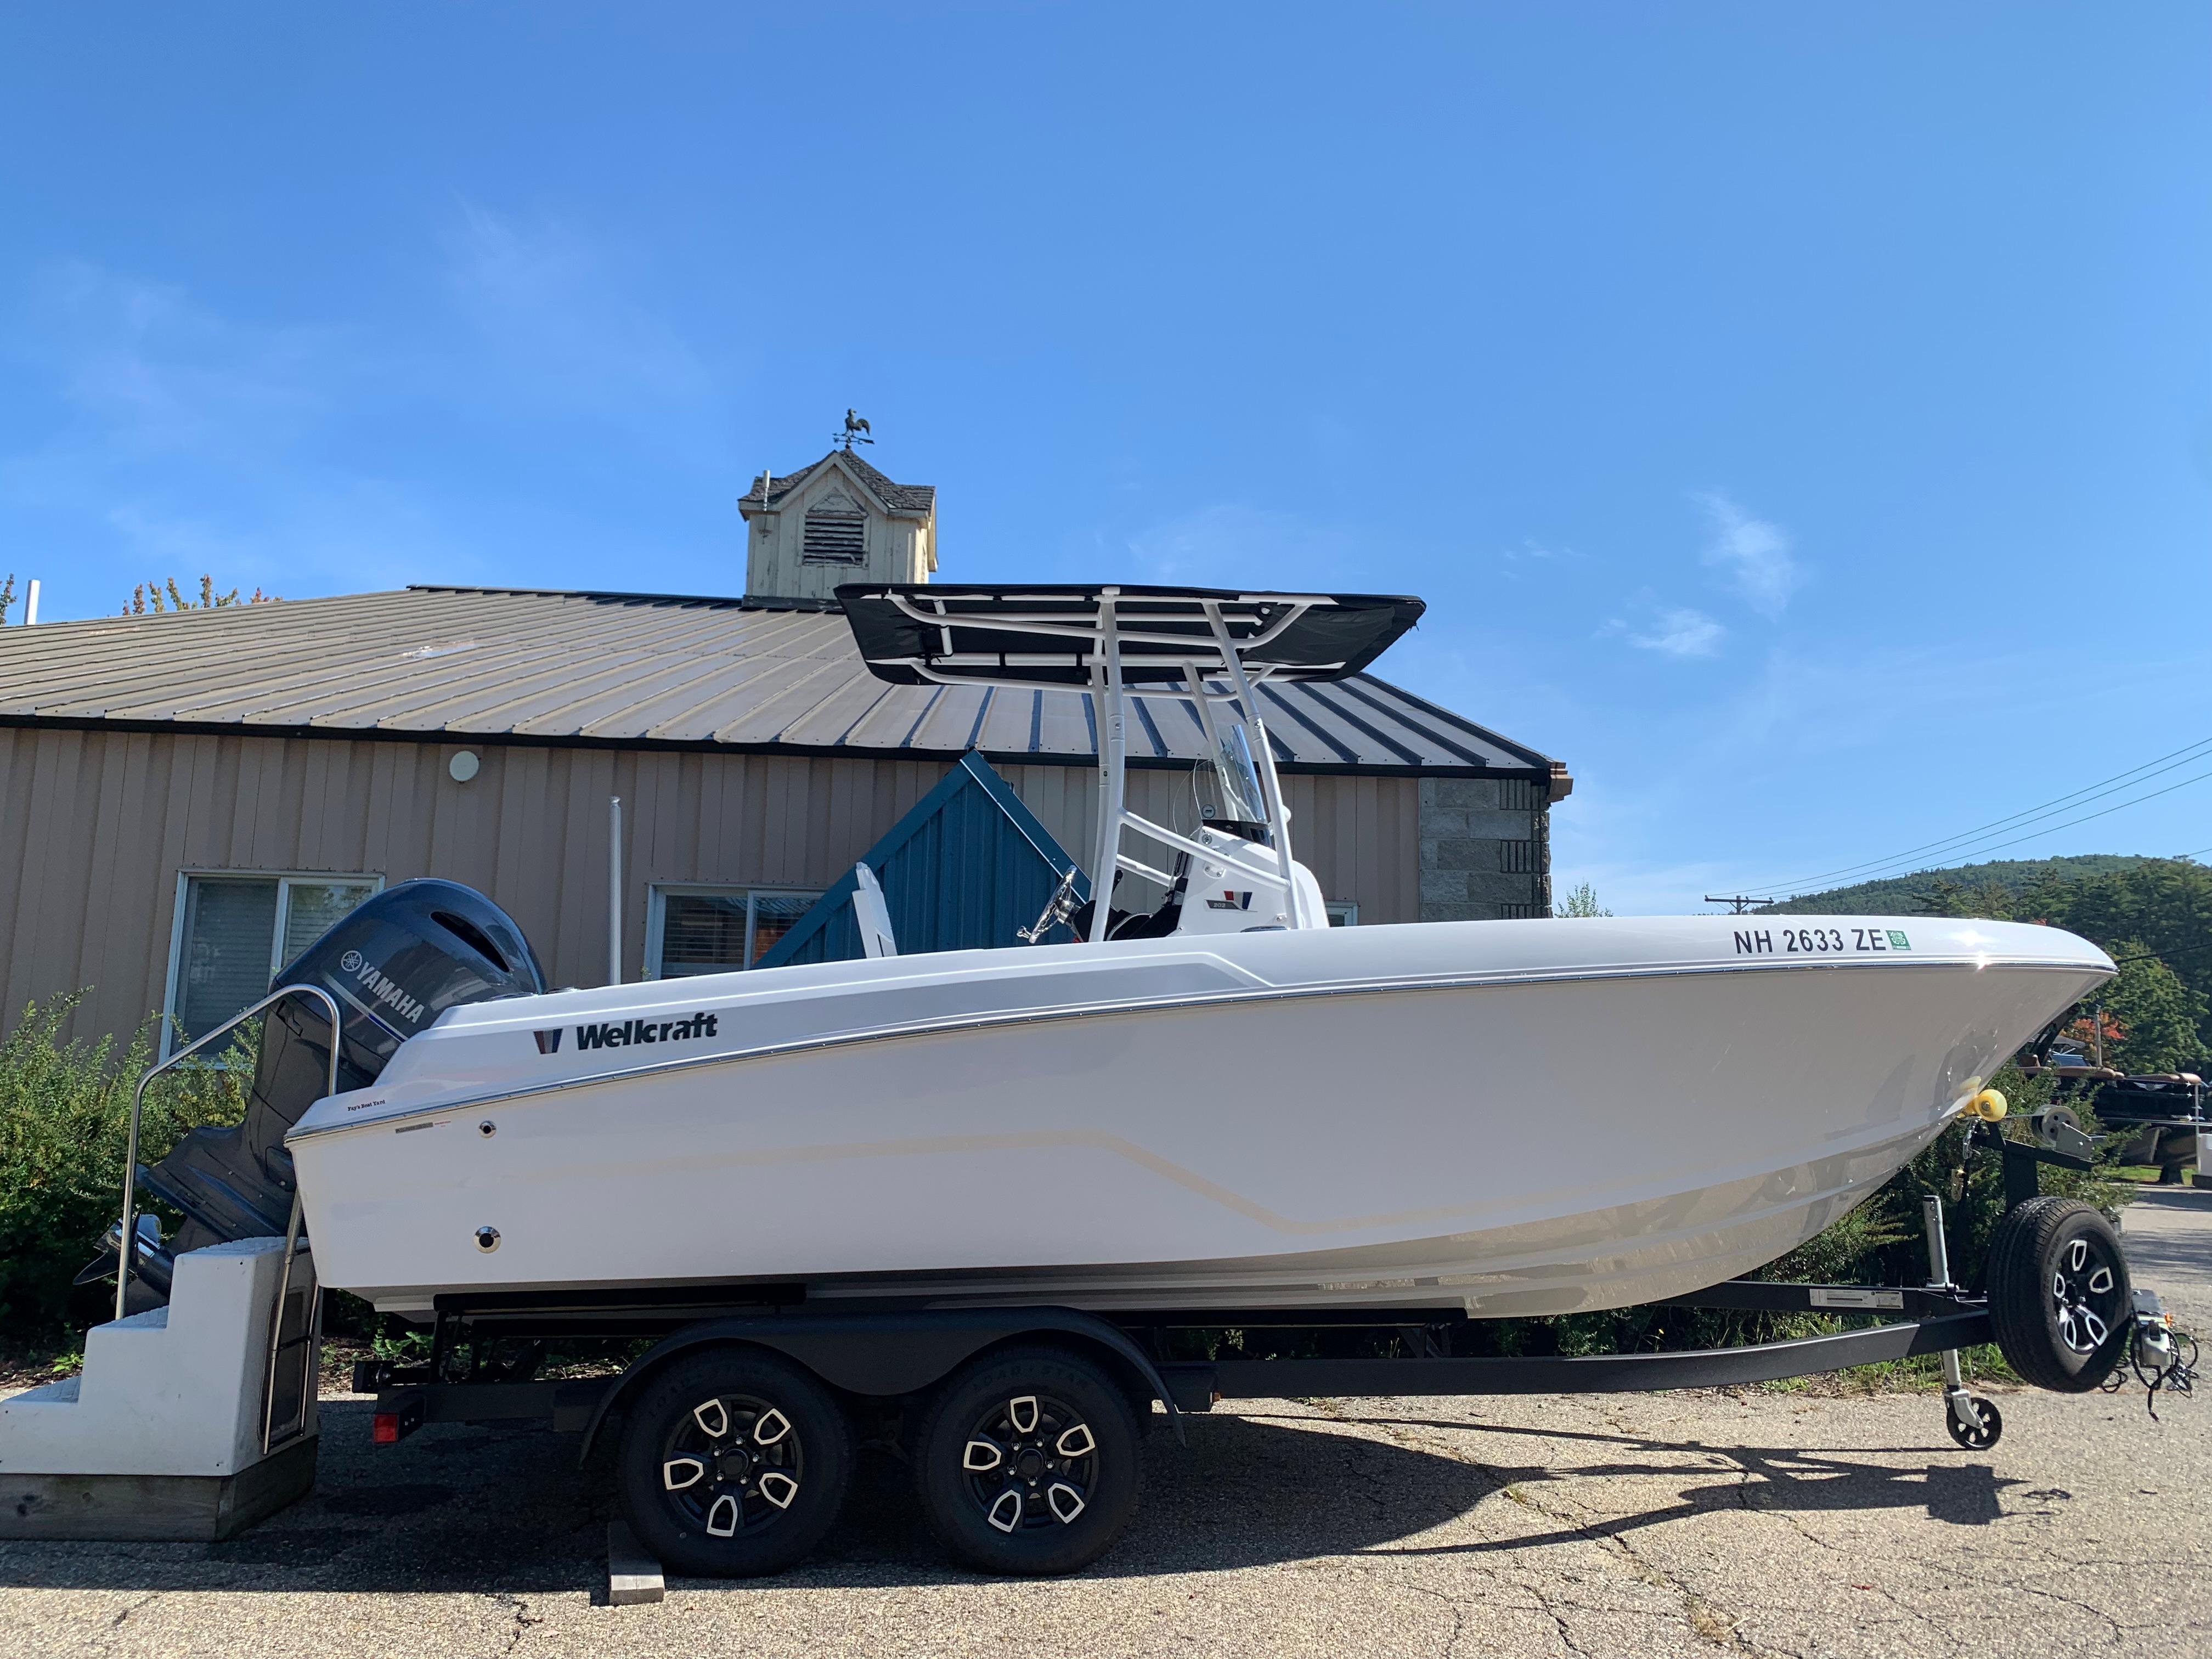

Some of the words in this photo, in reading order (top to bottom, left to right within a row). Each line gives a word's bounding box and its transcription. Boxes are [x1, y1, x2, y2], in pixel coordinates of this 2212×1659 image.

[1734, 930, 1773, 953] NH
[1783, 929, 1844, 952] 2633
[1850, 929, 1886, 951] ZE
[357, 961, 425, 1024] YAMAHA
[577, 1012, 718, 1051] Wellcraft
